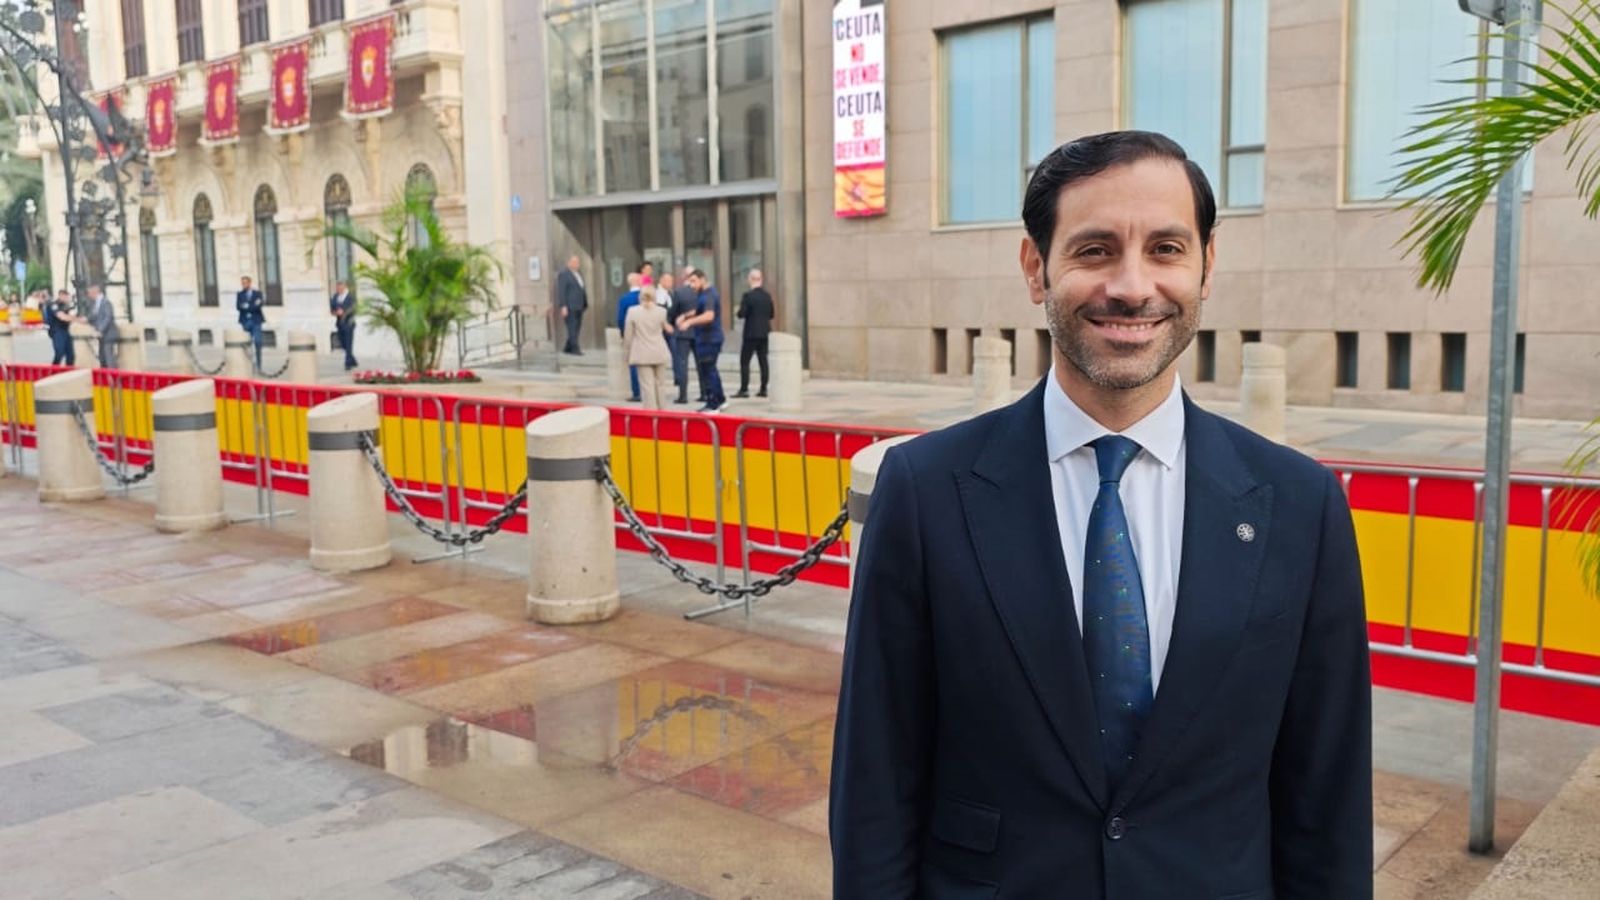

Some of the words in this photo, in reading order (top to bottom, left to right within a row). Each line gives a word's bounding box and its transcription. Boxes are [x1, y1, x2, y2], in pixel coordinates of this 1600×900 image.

[836, 12, 881, 41] CEUTA
[851, 43, 864, 62] NO
[836, 69, 847, 88] SE
[837, 91, 883, 117] CEUTA
[853, 119, 864, 138] SE
[836, 138, 881, 160] DEFIENDE
